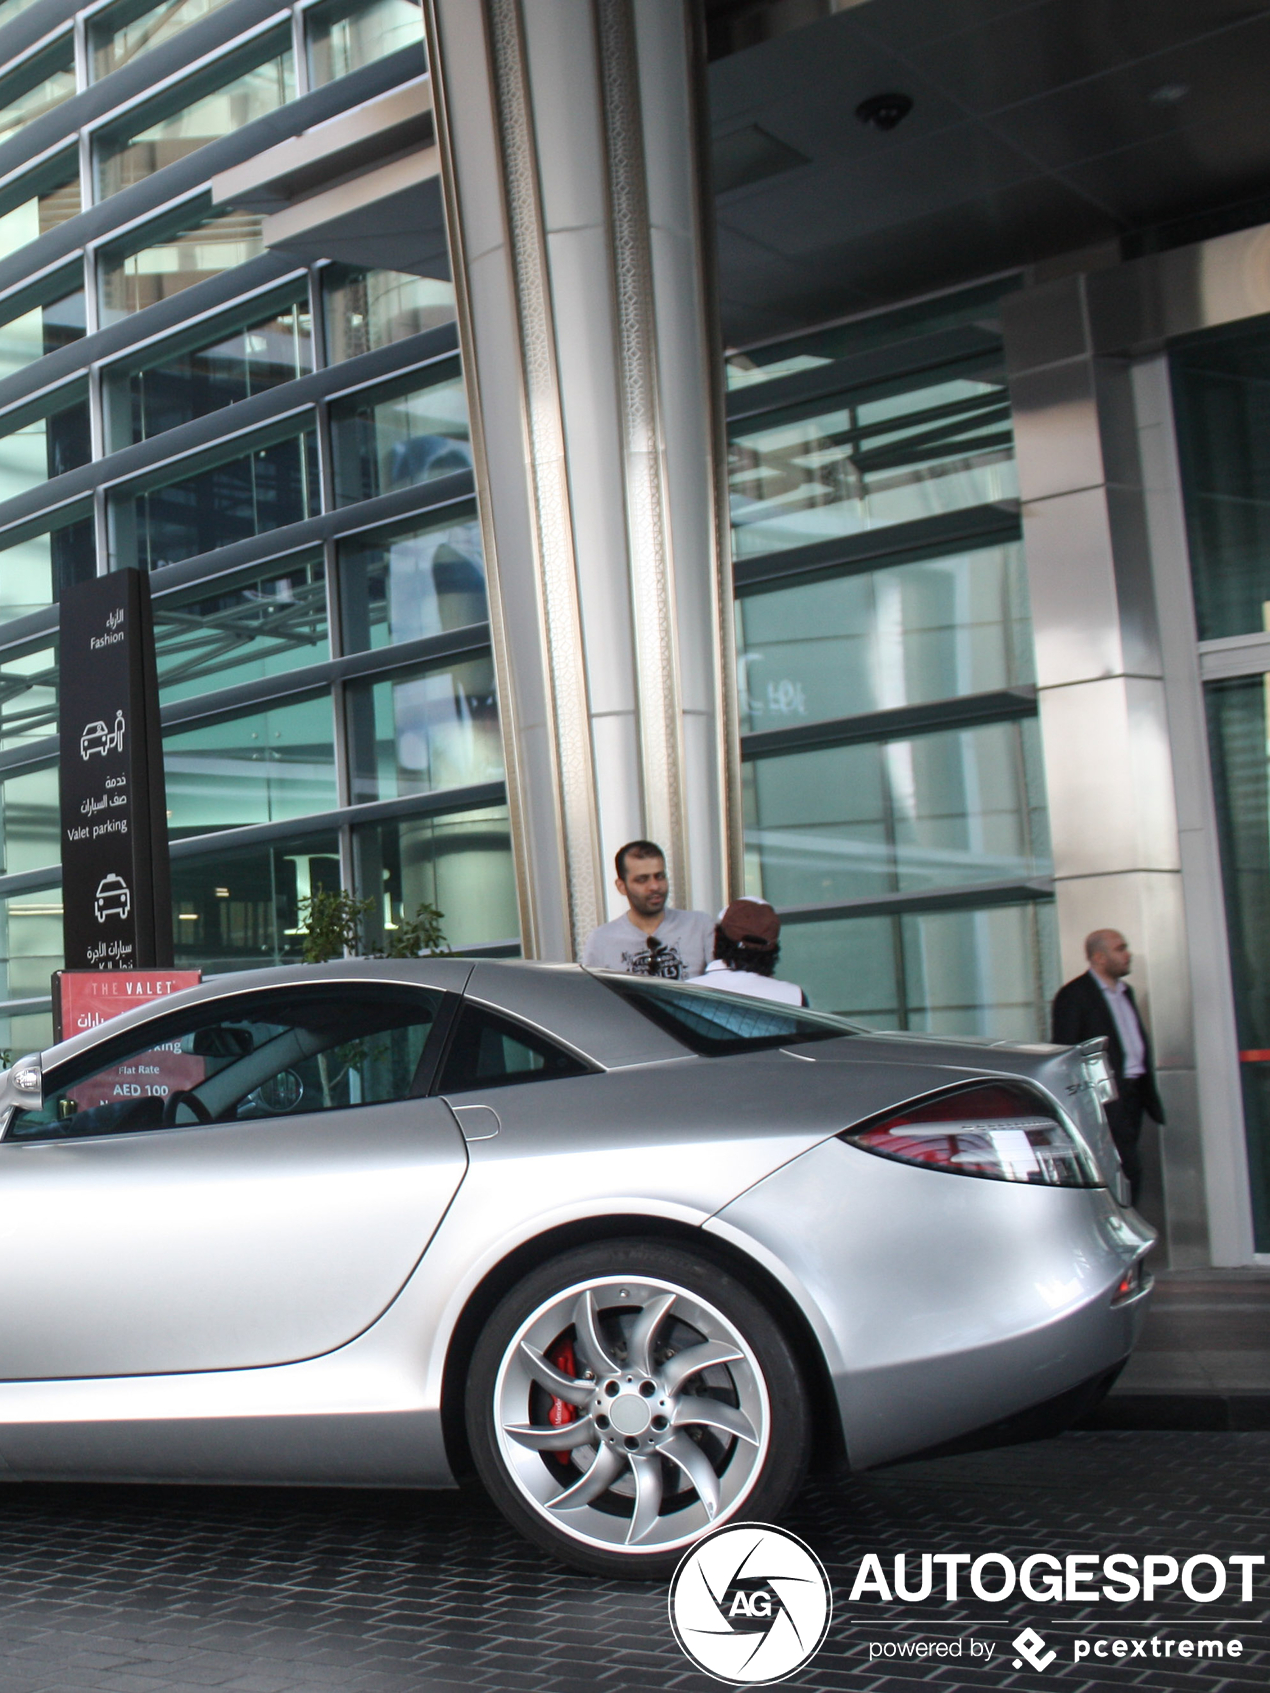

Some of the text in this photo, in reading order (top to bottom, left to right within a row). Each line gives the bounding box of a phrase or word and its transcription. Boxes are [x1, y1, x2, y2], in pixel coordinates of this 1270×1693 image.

[90, 631, 125, 650] Fashion
[105, 772, 127, 788] خدمة
[80, 792, 127, 817] صف السيارات
[67, 819, 128, 841] Valet parking
[108, 939, 133, 960] سيارات
[92, 981, 172, 995] THE VALET
[118, 1065, 160, 1074] Flat Rate
[113, 1084, 169, 1096] AED 100
